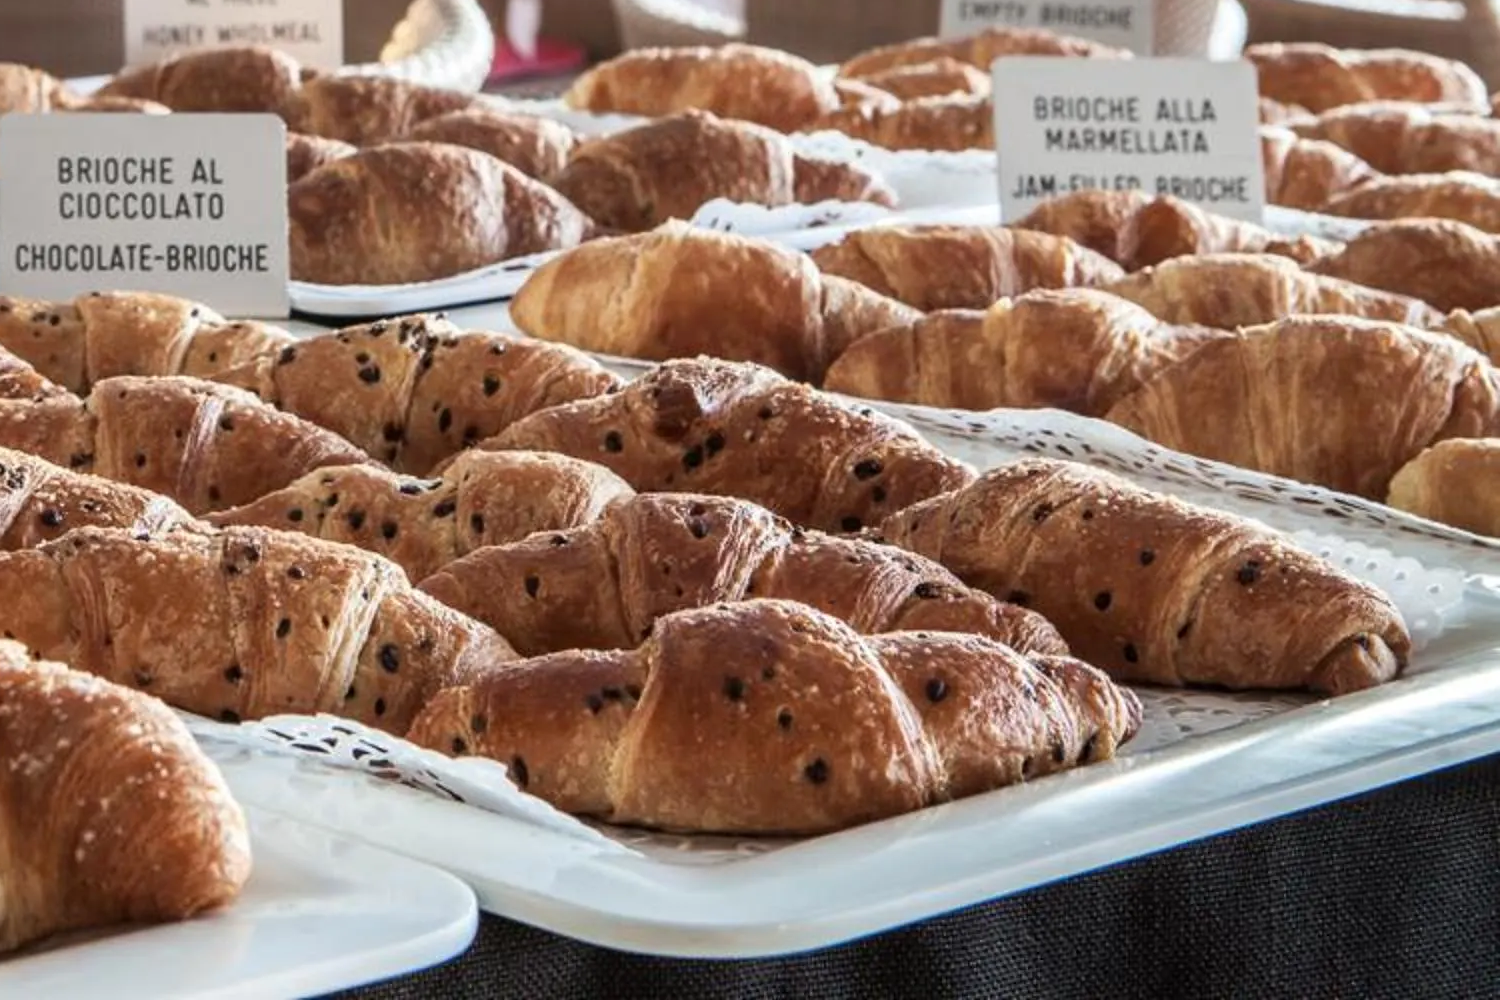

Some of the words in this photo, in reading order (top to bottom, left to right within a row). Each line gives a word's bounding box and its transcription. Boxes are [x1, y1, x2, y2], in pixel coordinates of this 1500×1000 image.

[1033, 96, 1141, 122] BRIOCHE
[1155, 97, 1218, 123] ALLA
[1045, 128, 1210, 154] MARMELLATA
[57, 156, 174, 185] BRIOCHE
[191, 156, 225, 185] AL
[59, 191, 225, 220] CIOCCOLATO
[15, 244, 270, 273] CHOCOLATE-BRIOCHE
